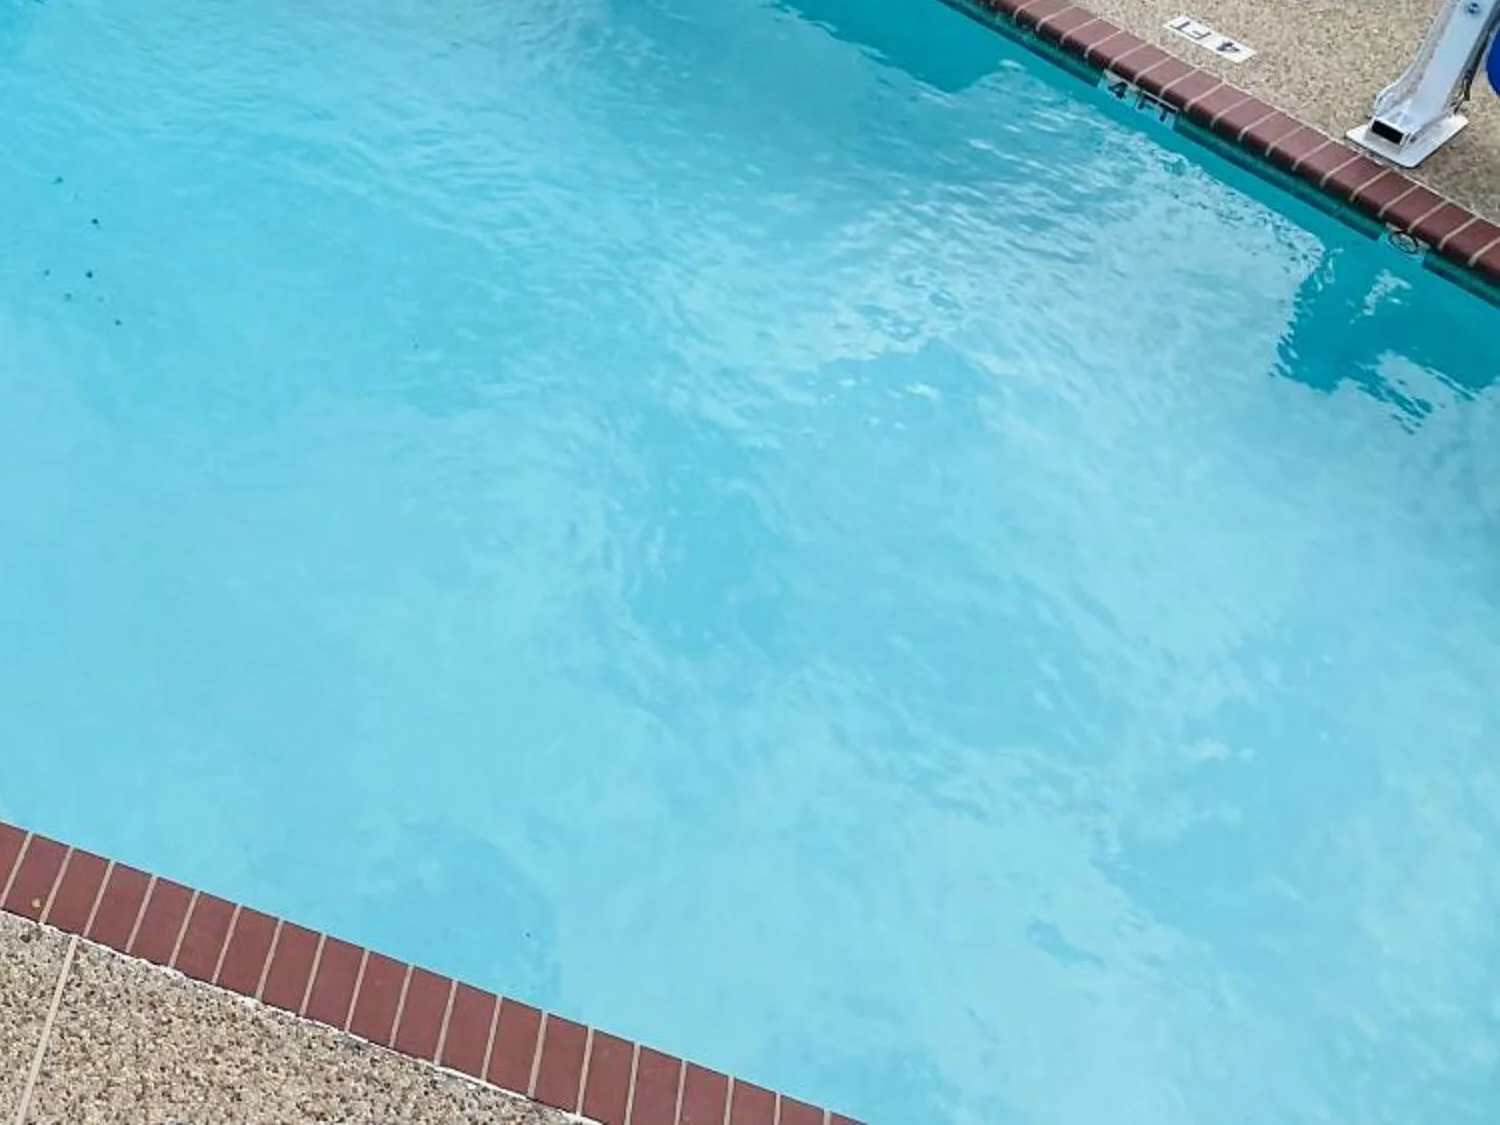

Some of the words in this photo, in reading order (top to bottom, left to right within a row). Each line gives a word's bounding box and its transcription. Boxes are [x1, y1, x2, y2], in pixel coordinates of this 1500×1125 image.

[1169, 21, 1213, 41] FT
[1216, 41, 1241, 53] 4
[1107, 81, 1128, 100] 4
[1135, 93, 1178, 123] FT
